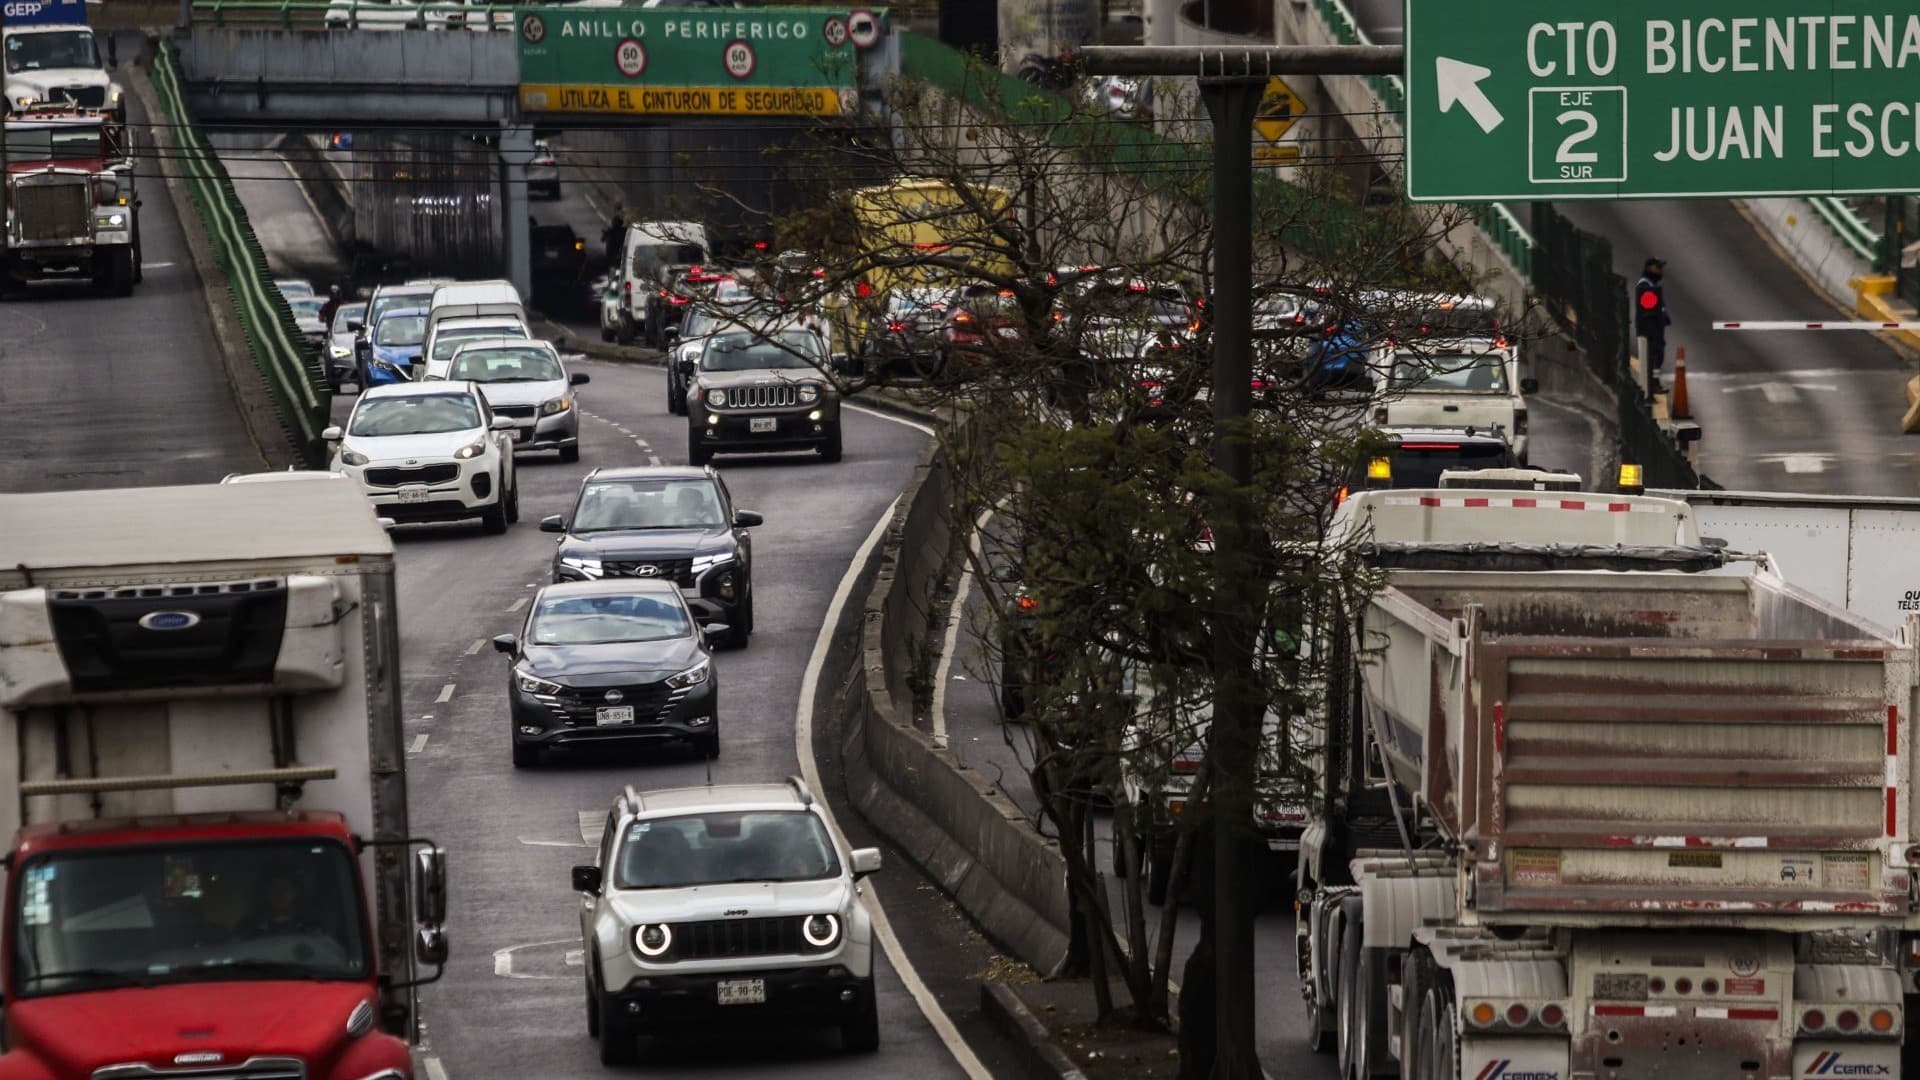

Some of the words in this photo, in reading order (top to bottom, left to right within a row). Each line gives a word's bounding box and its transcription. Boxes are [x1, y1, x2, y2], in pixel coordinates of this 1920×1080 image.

[4, 3, 42, 16] GEPP
[562, 20, 645, 37] ANILLO
[665, 21, 807, 39] PERIFERICO
[623, 47, 638, 60] 60
[1527, 21, 1617, 77] CTO
[1646, 15, 1920, 74] BICENTENA
[731, 49, 746, 62] 60
[560, 90, 610, 109] UTILIZA
[618, 90, 634, 109] EL
[642, 90, 710, 110] CINTURON
[719, 91, 737, 110] DE
[745, 92, 825, 111] SEGURIDAD
[1560, 92, 1592, 106] EJE
[1555, 110, 1598, 162] 2
[1654, 106, 1783, 161] JUAN
[1813, 102, 1920, 157] ESC
[1561, 166, 1592, 179] SUR
